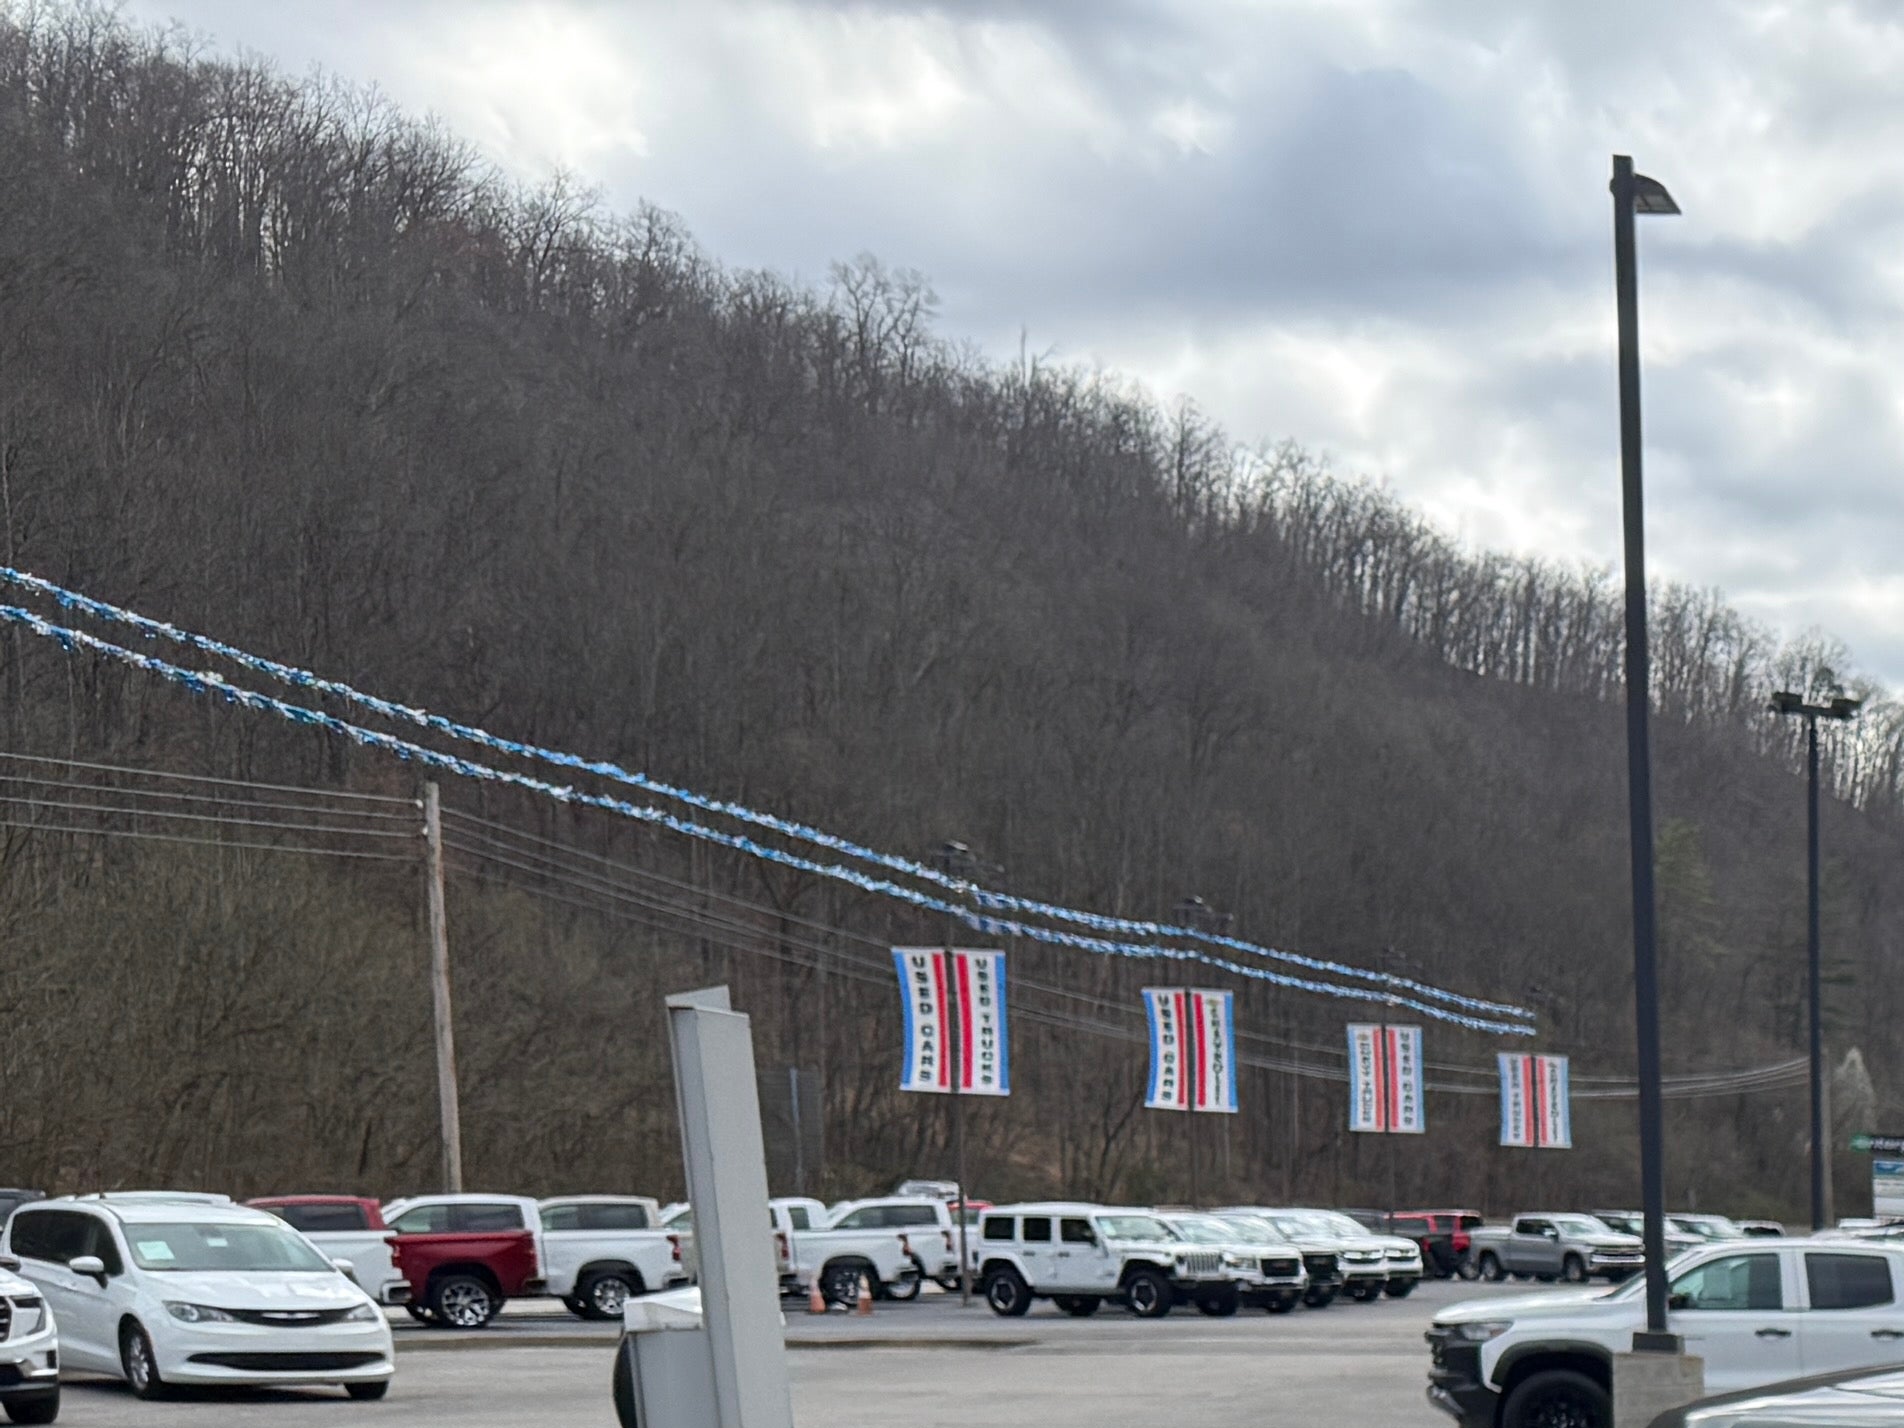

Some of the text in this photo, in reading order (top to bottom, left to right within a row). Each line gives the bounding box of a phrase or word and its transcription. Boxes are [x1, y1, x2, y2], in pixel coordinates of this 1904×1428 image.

[911, 956, 935, 1082] USED CARS
[975, 958, 994, 1085] USED TRUCKS
